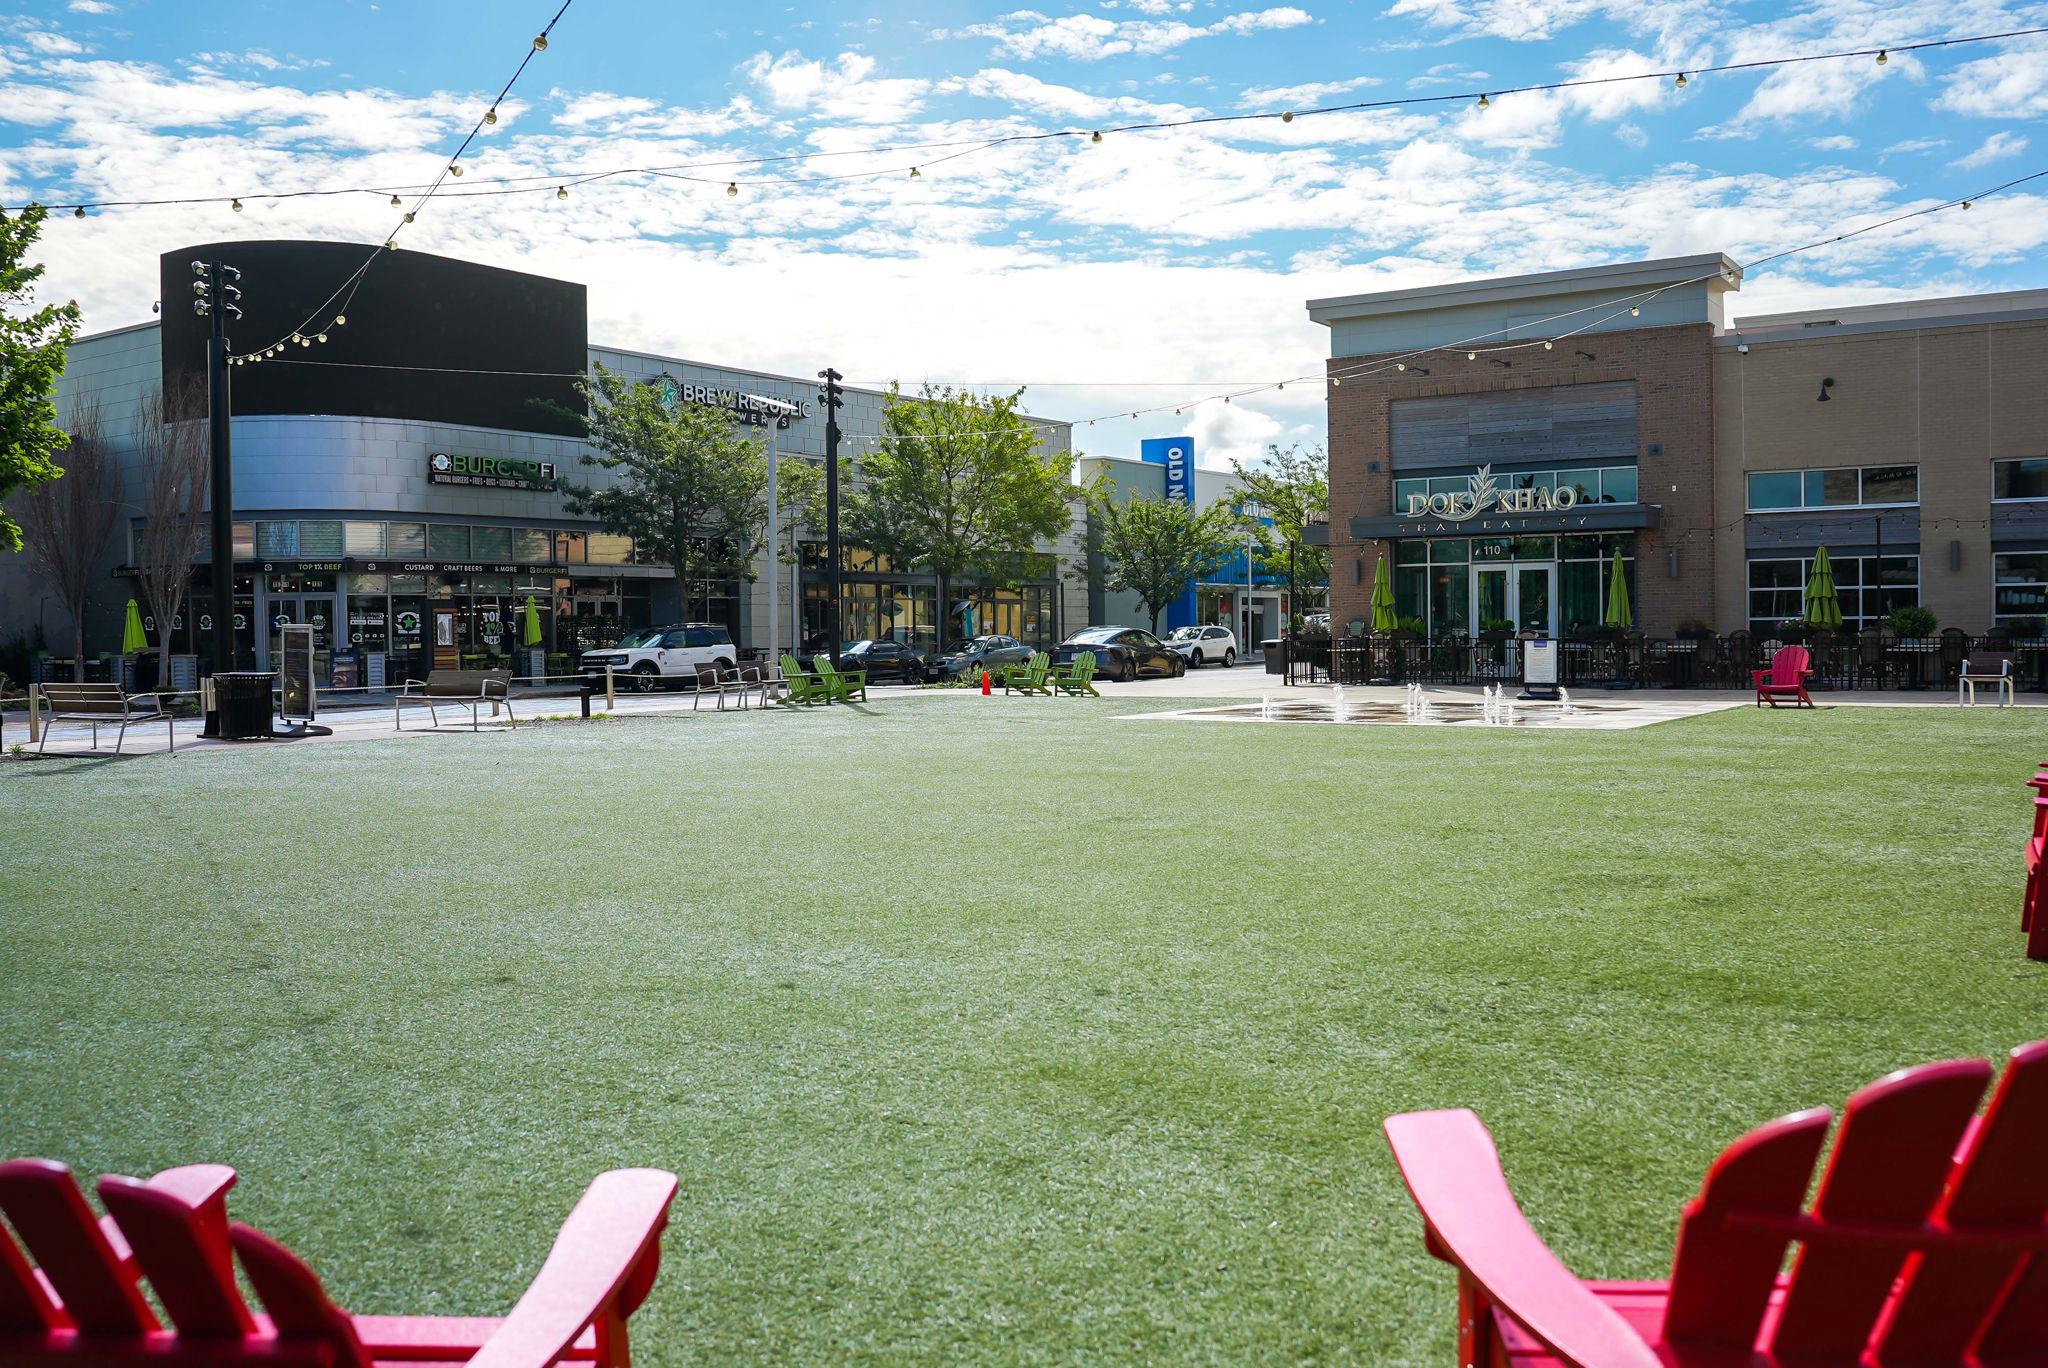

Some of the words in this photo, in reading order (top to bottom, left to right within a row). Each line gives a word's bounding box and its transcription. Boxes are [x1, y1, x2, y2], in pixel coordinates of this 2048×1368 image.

[684, 384, 732, 407] BREW
[1168, 447, 1184, 481] OLD
[1407, 491, 1468, 518] DOK
[1496, 486, 1578, 514] KHAO
[1399, 522, 1460, 533] THAI
[1484, 545, 1501, 555] 110
[443, 564, 463, 572] CRAFT
